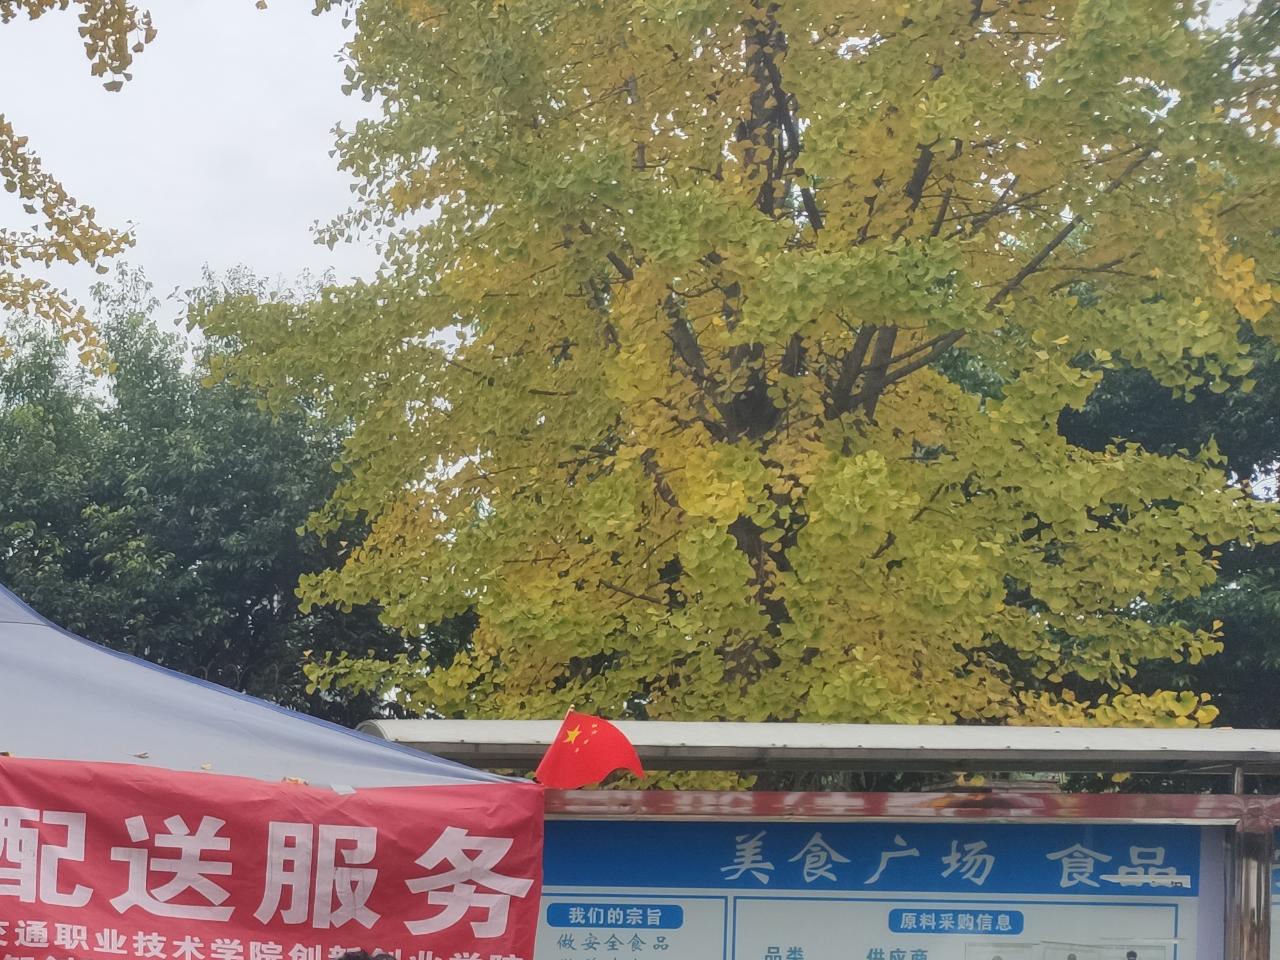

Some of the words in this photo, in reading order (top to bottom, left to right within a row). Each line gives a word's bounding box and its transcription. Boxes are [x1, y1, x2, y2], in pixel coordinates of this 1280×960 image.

[720, 830, 997, 886] 美食广场
[1046, 843, 1177, 888] 食品
[568, 907, 662, 927] 我们的宗旨
[899, 912, 1013, 932] 原料采购信息
[556, 933, 669, 952] 做安全食品
